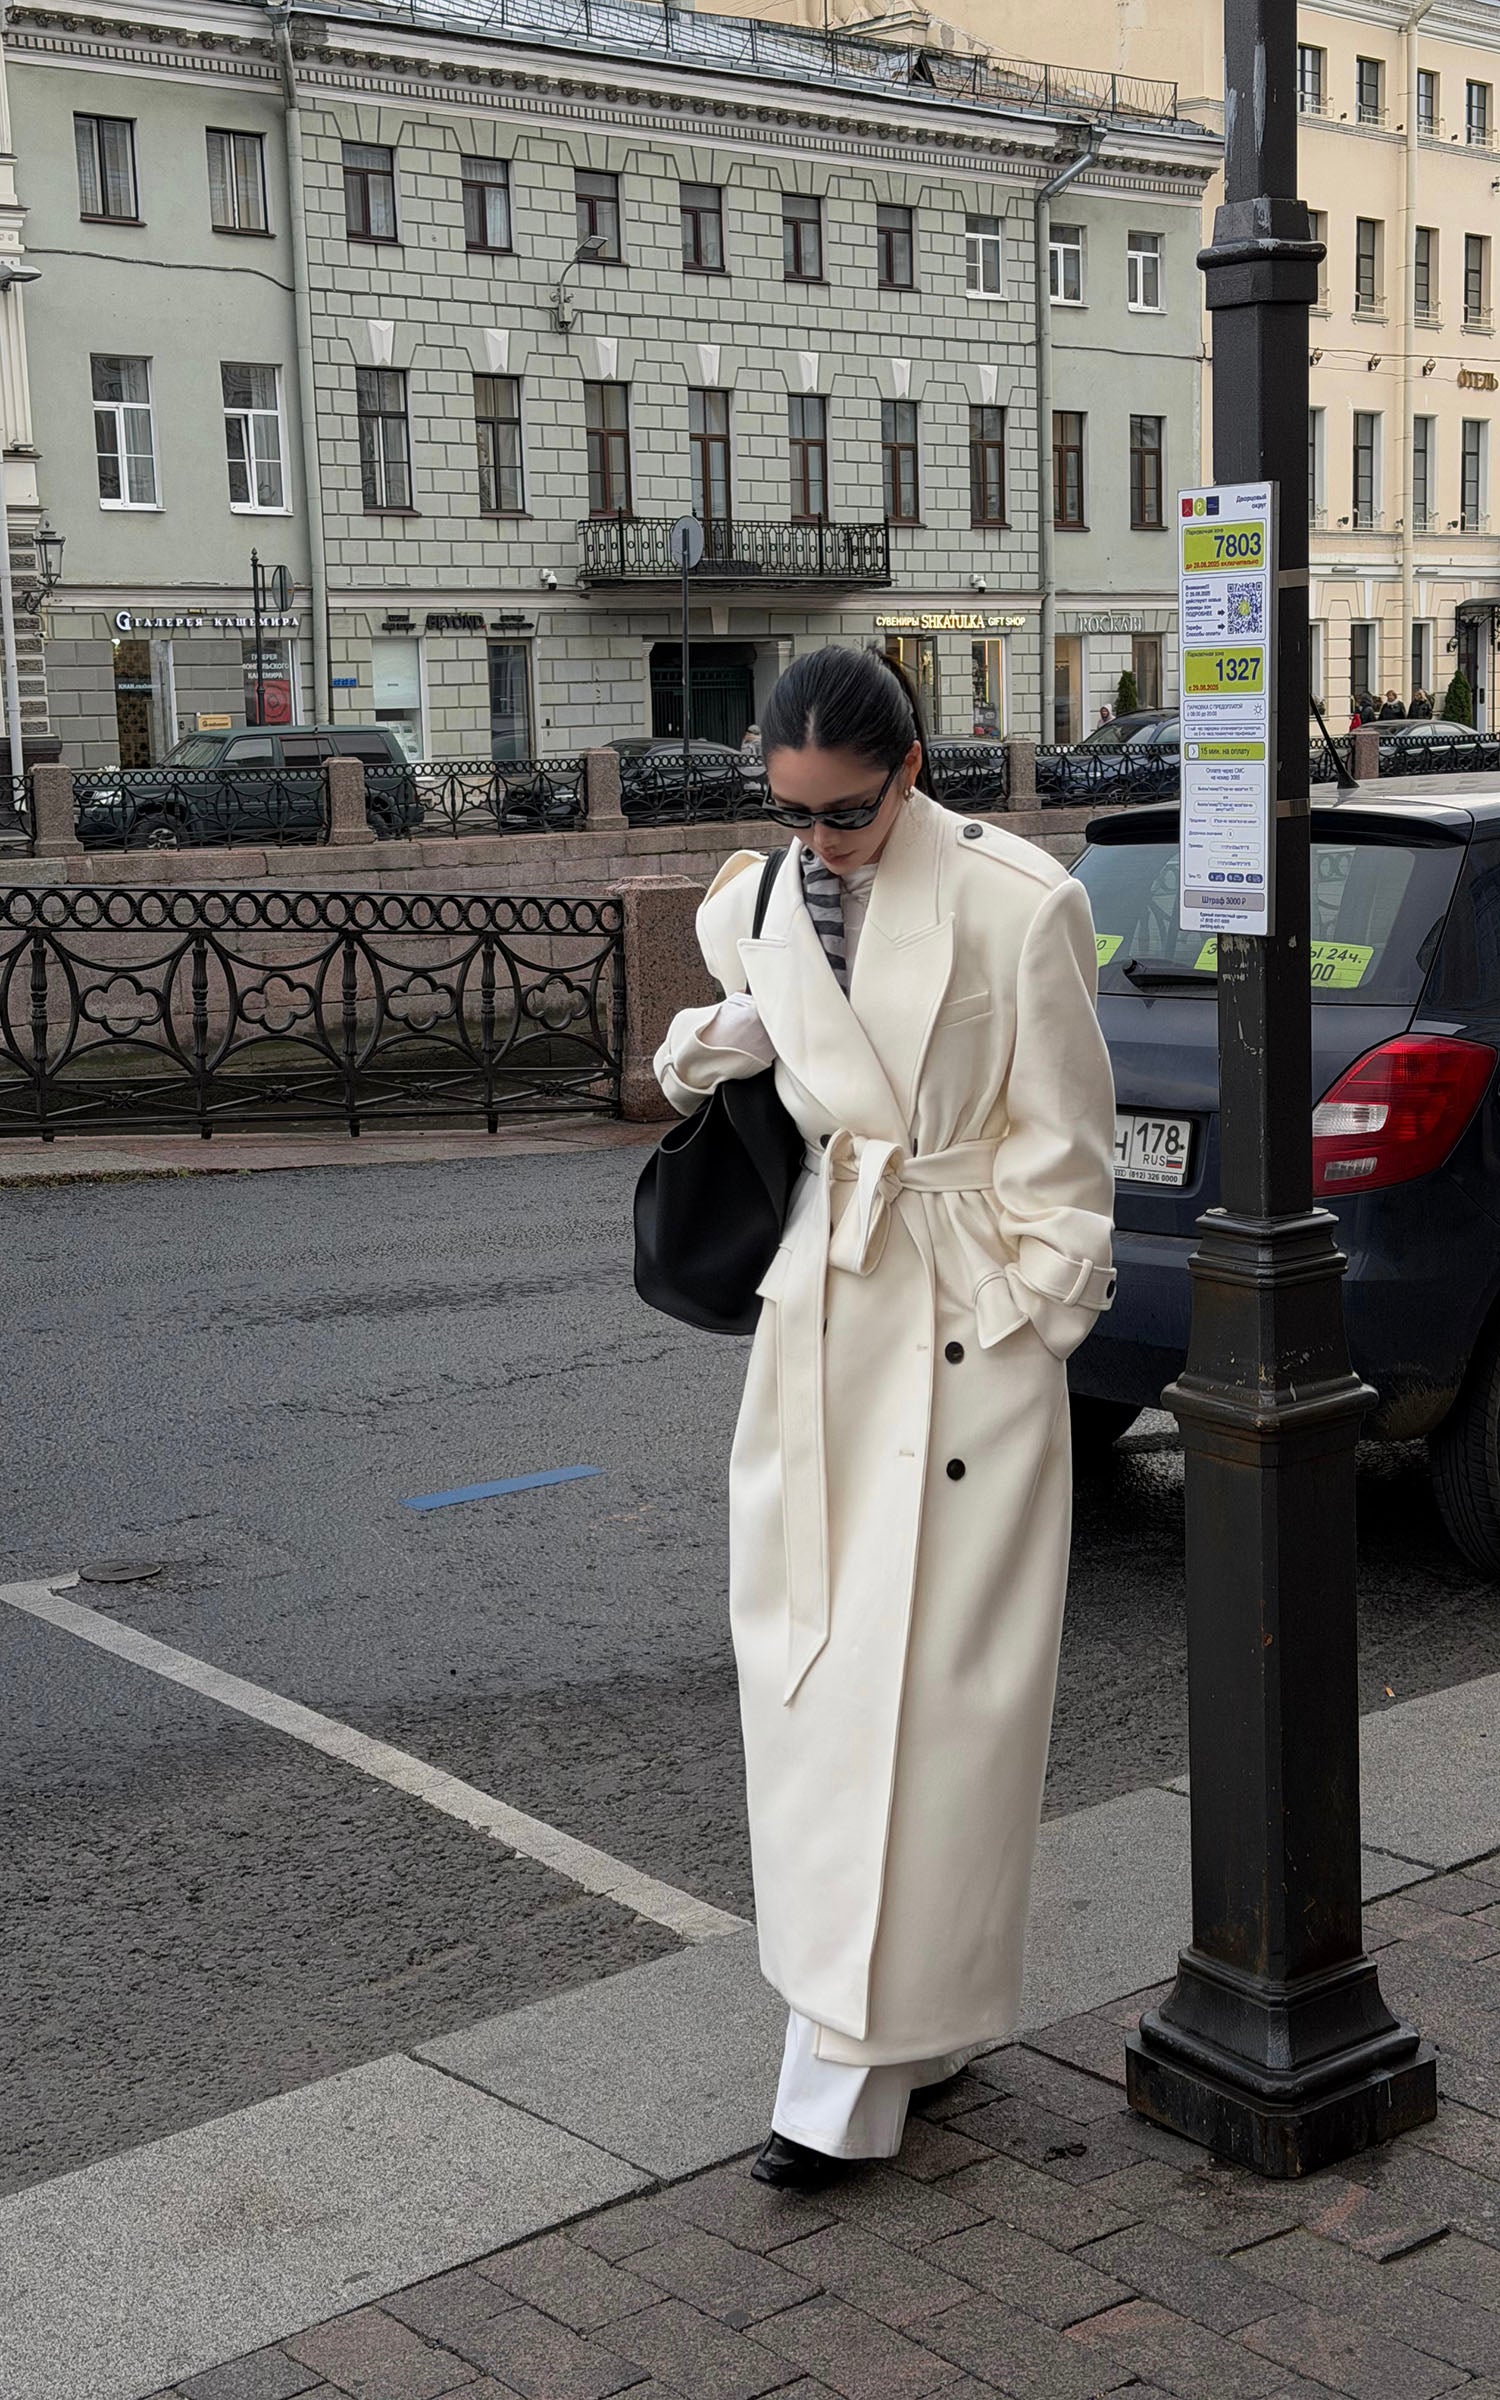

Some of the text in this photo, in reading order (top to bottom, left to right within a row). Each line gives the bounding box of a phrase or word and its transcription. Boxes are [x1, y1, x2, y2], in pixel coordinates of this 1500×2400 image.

[1457, 369, 1499, 391] ОТЕЛЬ
[1236, 493, 1267, 504] Дворцовый
[1251, 502, 1267, 510] округ
[1214, 532, 1262, 558] 7803
[134, 617, 204, 628] ГАЛЕРЕЯ
[876, 615, 1026, 629] СУВЕНИРЫ SHKATULKA GIFT SHOP
[1216, 657, 1260, 681] 1327
[1230, 748, 1249, 756] оплату
[1202, 896, 1225, 906] Штраф
[1226, 897, 1241, 905] 3000
[1136, 1122, 1180, 1156] 178
[1143, 1153, 1166, 1167] RUS
[1128, 1170, 1146, 1180] (812)
[1161, 1175, 1178, 1183] 0000
